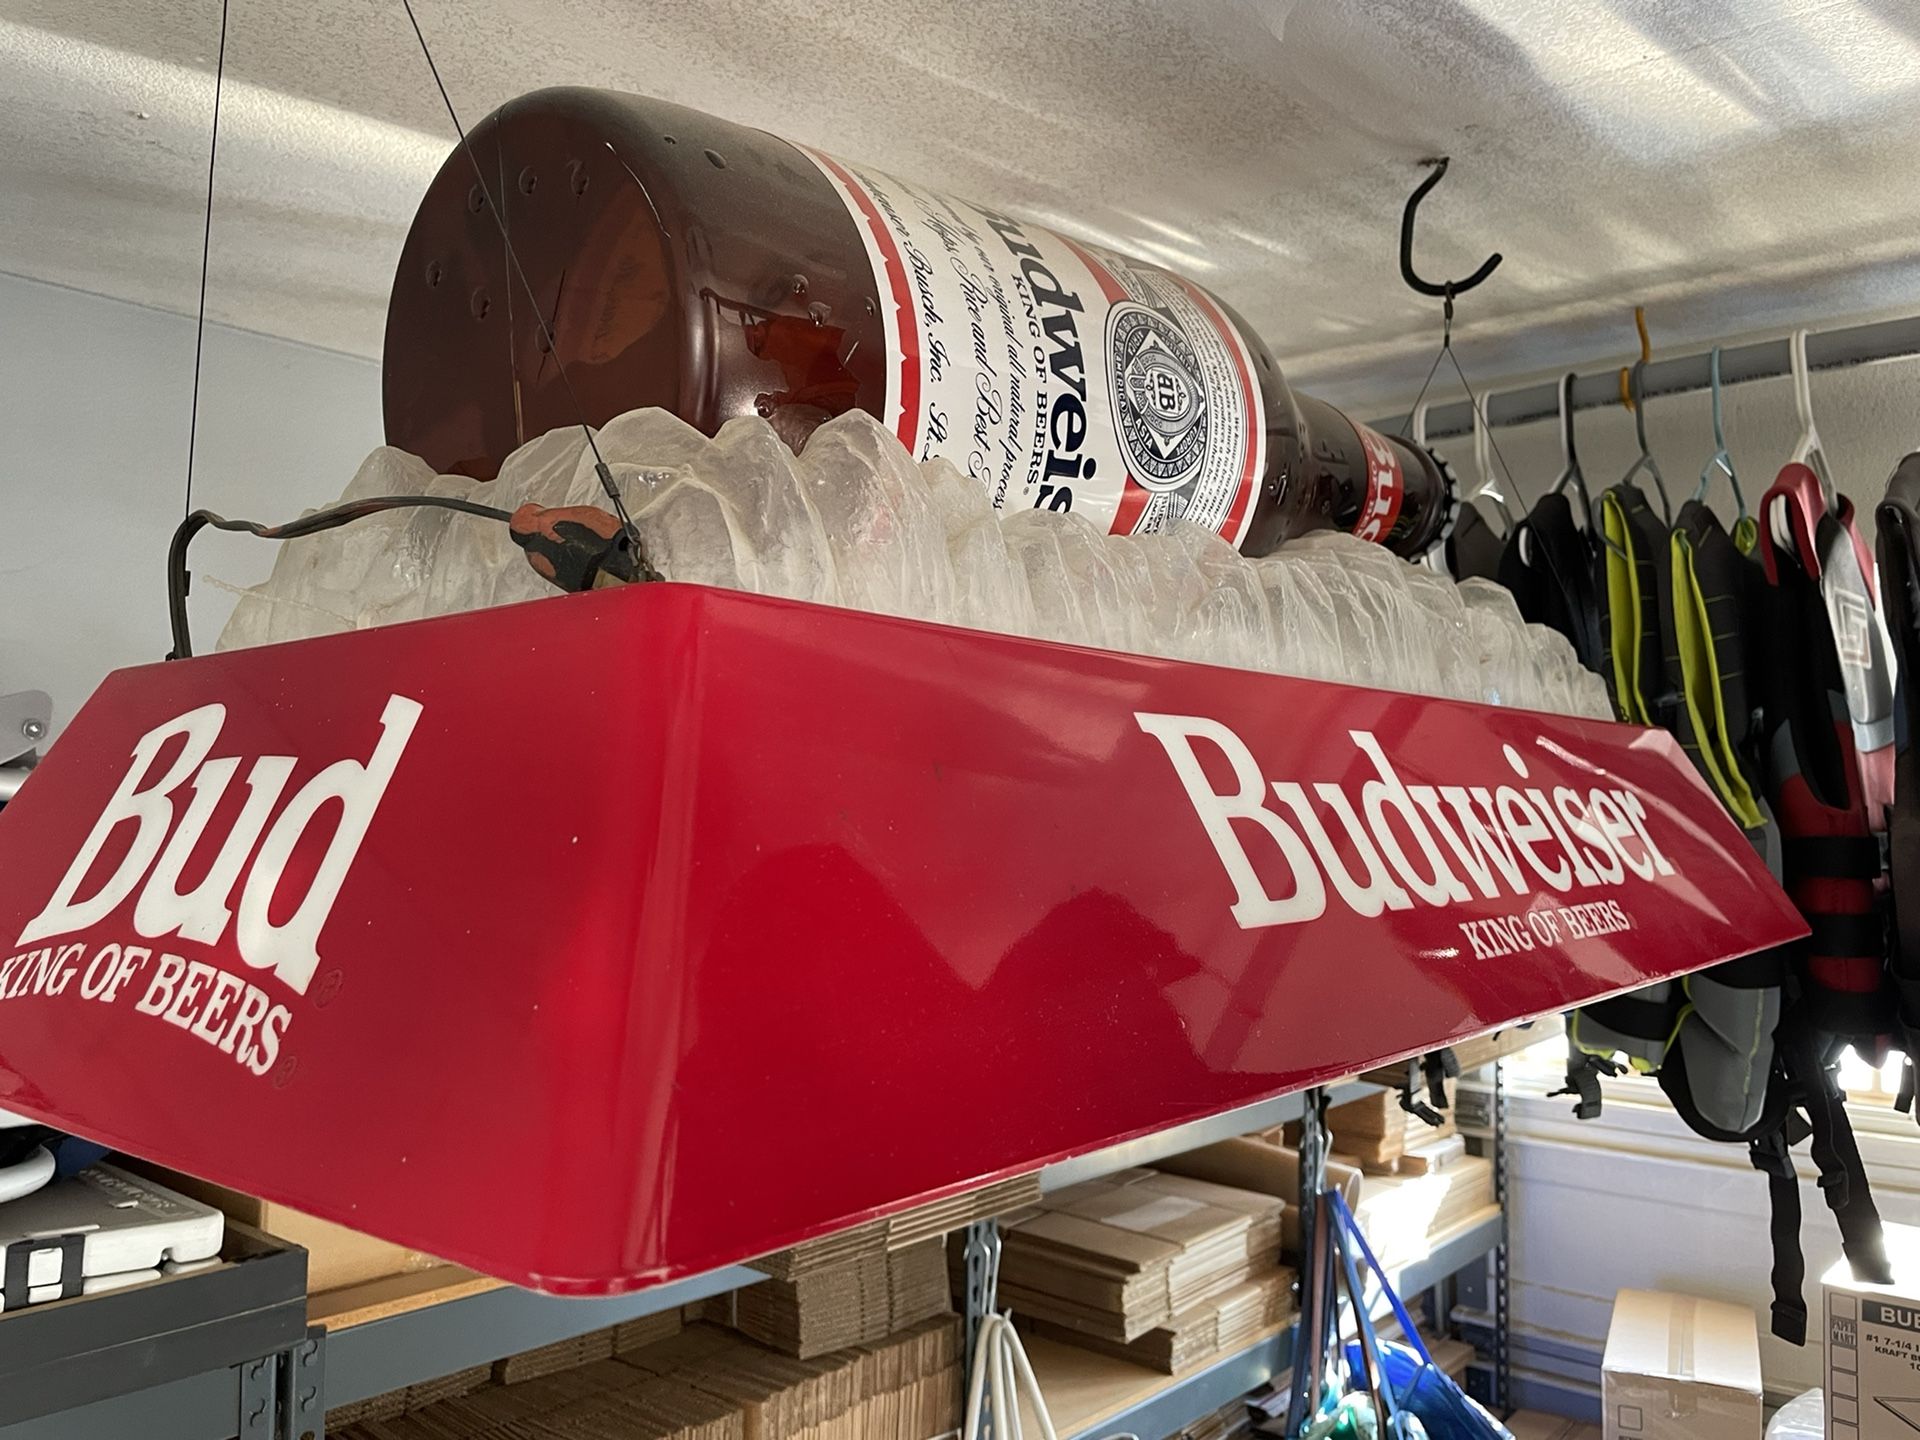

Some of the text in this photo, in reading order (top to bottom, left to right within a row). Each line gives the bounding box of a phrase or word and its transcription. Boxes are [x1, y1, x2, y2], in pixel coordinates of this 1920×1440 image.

[949, 256, 991, 326] Rice
[987, 275, 1024, 348] original
[928, 333, 951, 384] Inc.
[946, 195, 1097, 514] udweis
[970, 321, 998, 377] and
[1011, 272, 1049, 486] KING OF BEERS
[1114, 352, 1128, 411] AMERICA
[928, 401, 949, 443] St.
[974, 372, 1004, 451] Best
[1005, 372, 1027, 453] natural
[1135, 417, 1154, 450] ASIA
[991, 437, 1020, 510] process
[15, 693, 424, 996] Bud
[1133, 711, 1676, 930] Budweiser
[1458, 899, 1631, 960] KING OF BEERS
[0, 943, 293, 1076] KING OF BEERS
[1874, 1345, 1908, 1359] KRAFT
